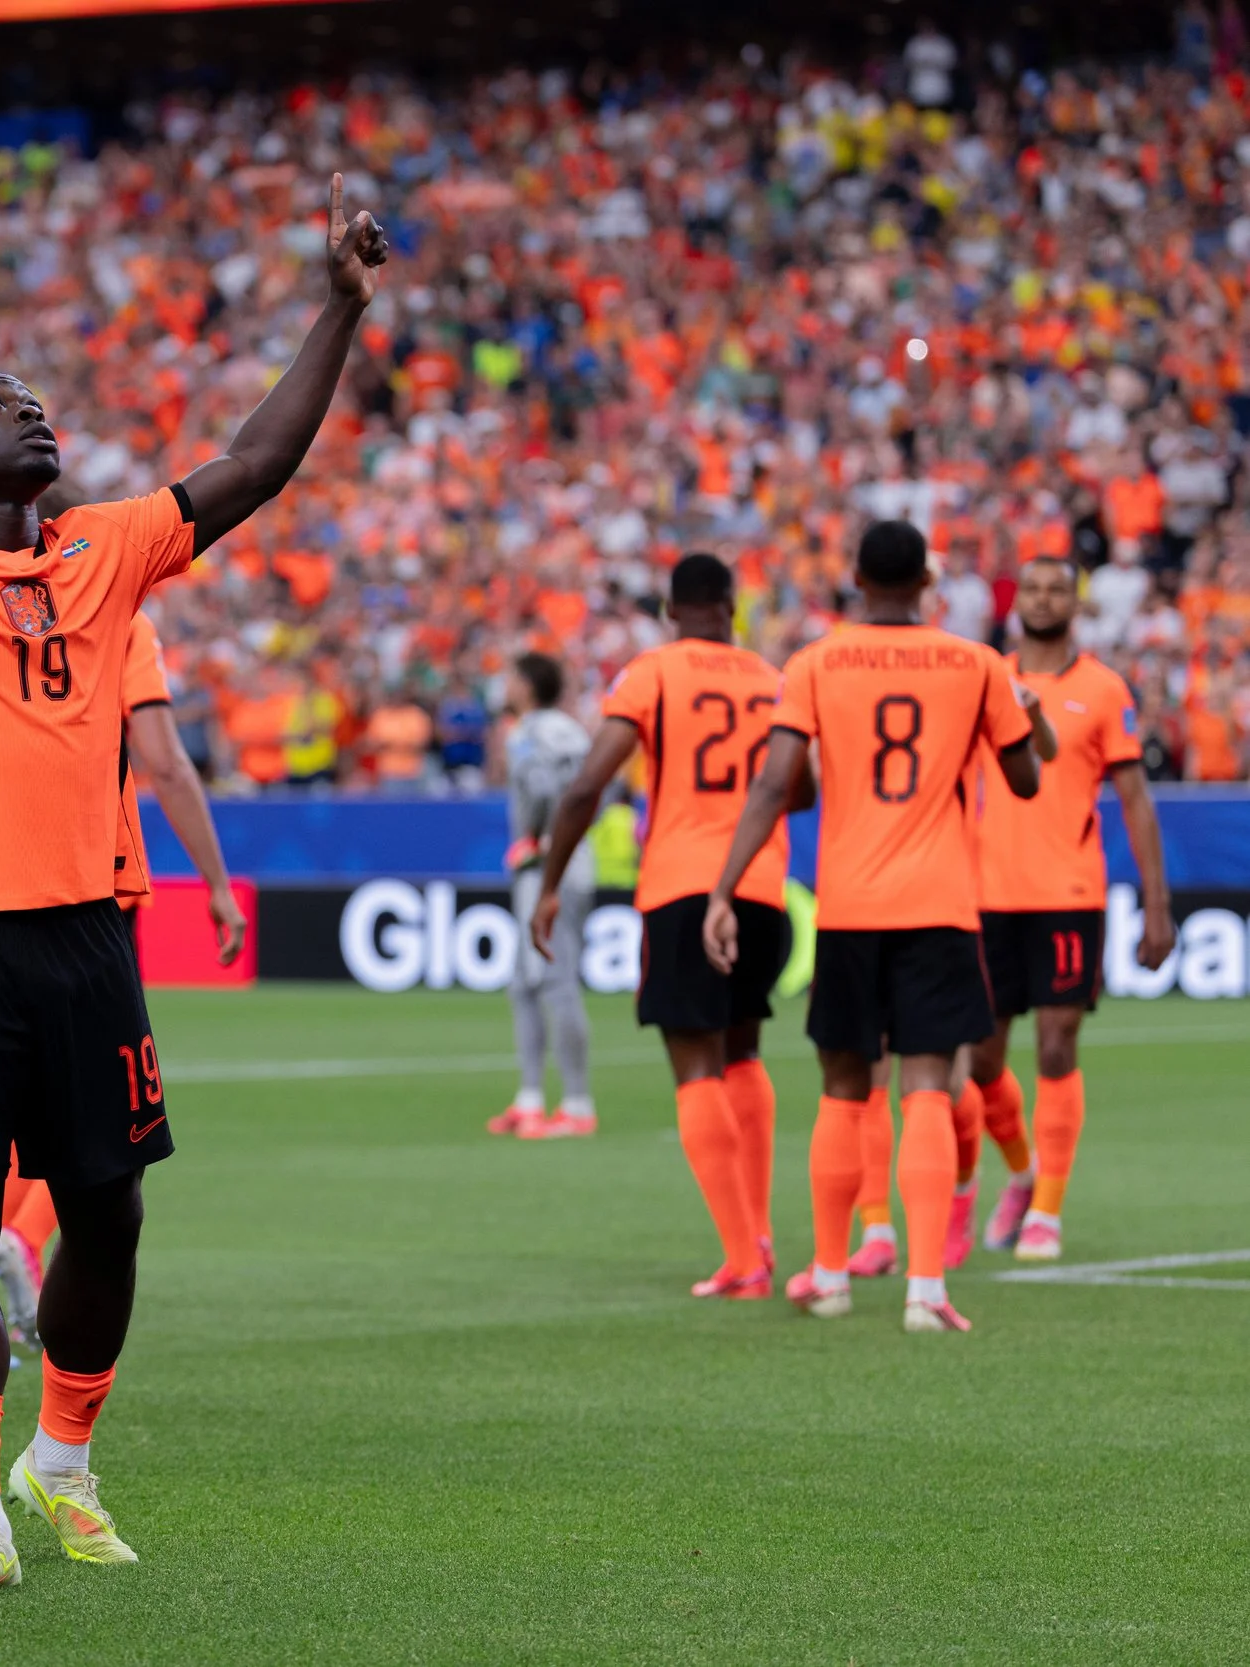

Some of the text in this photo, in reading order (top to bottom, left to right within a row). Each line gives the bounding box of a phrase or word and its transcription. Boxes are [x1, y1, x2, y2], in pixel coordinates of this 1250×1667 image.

[11, 633, 72, 701] 19
[874, 694, 922, 802] 8
[1052, 930, 1084, 977] 11
[118, 1034, 164, 1111] 19
